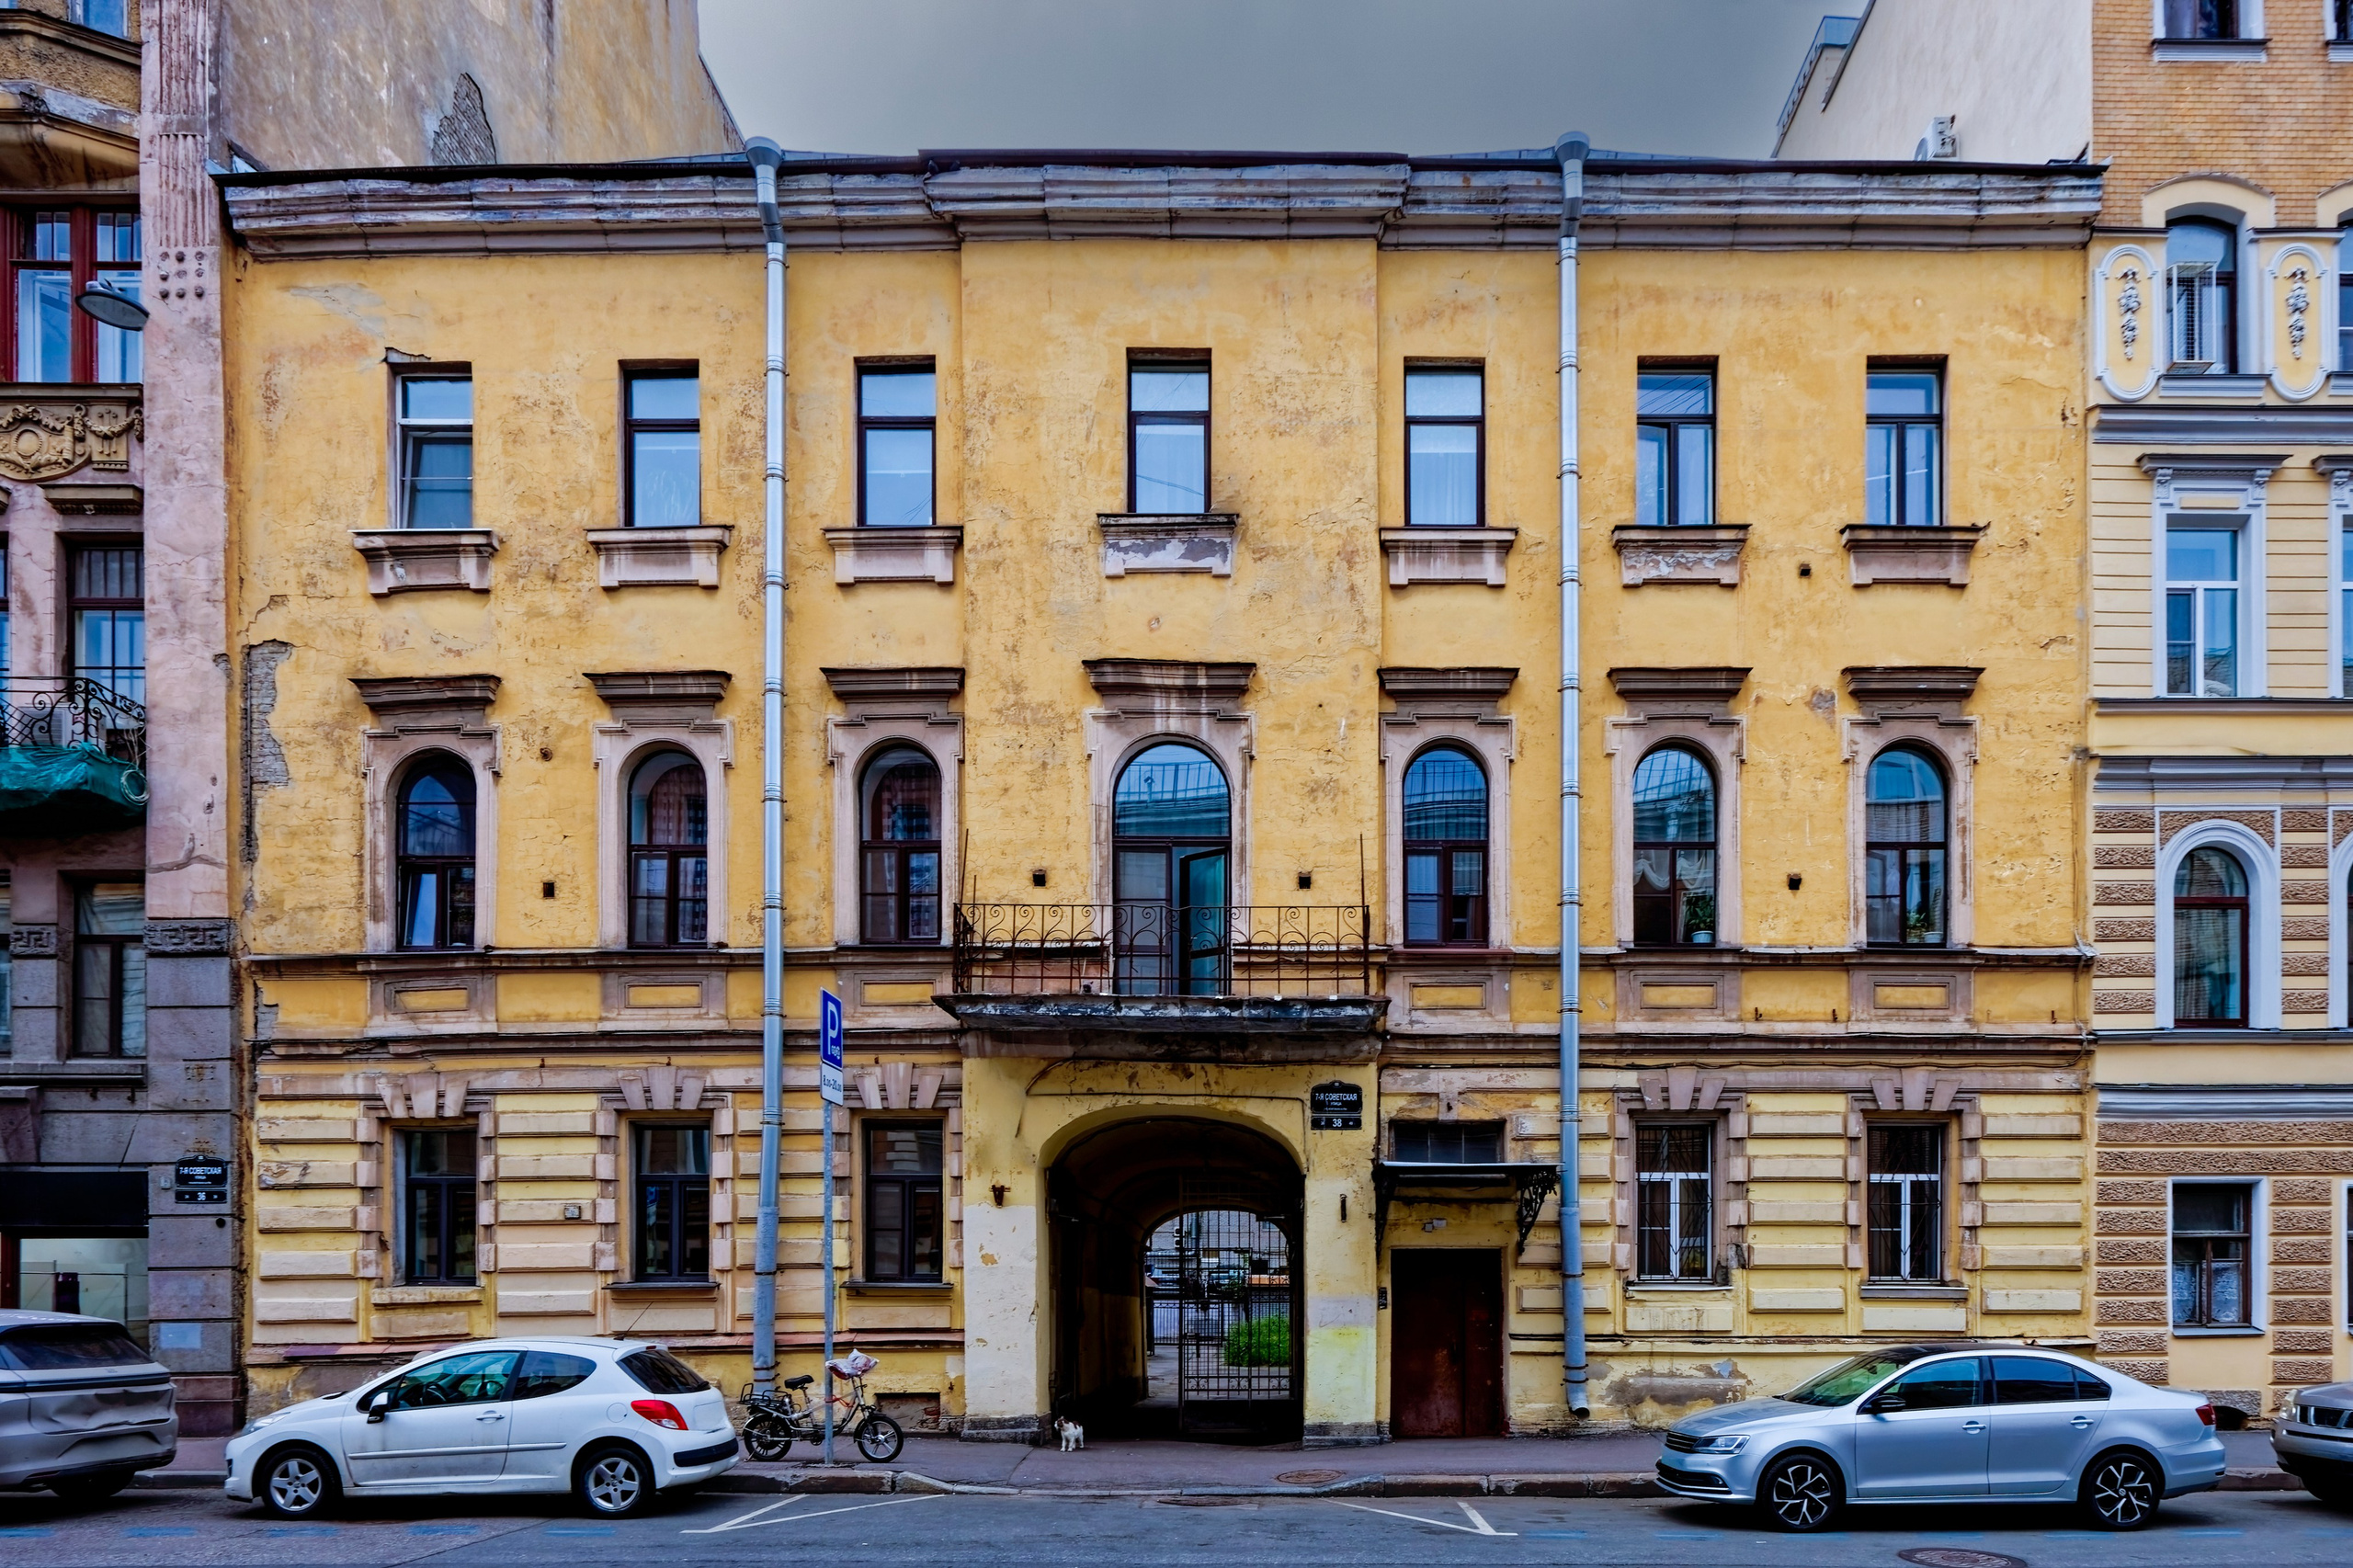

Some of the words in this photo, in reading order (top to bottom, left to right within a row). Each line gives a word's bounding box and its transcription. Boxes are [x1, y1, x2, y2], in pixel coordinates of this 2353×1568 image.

[827, 1001, 838, 1055] P
[1315, 1093, 1324, 1101] 7-Я
[1324, 1093, 1358, 1101] СОВЕТСКАЯ
[1332, 1119, 1342, 1128] 38
[179, 1166, 188, 1175] 7-Я
[189, 1166, 222, 1175] СОВЕТСКАЯ
[197, 1192, 206, 1200] 36
